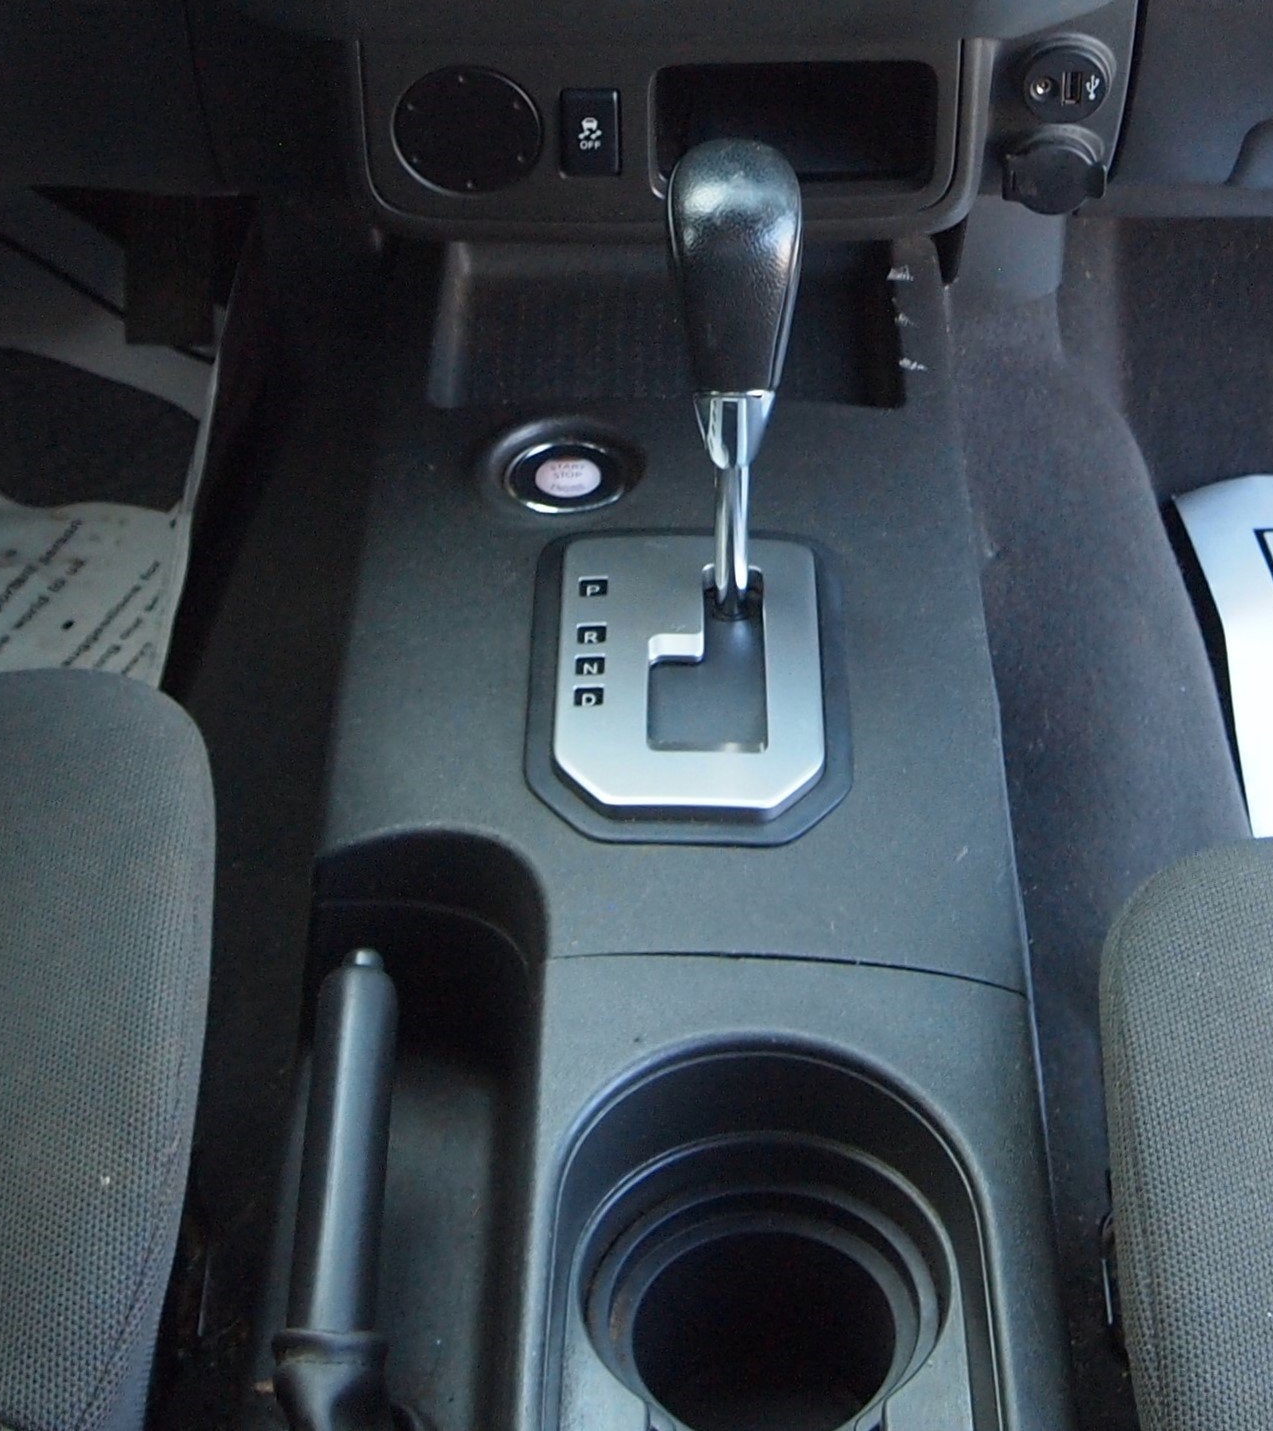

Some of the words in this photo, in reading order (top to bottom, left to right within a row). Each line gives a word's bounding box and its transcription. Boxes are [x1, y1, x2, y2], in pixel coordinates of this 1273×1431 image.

[579, 140, 602, 151] OFF
[586, 584, 600, 597] P
[583, 630, 598, 644] R
[582, 661, 598, 675] N
[581, 692, 597, 707] D
